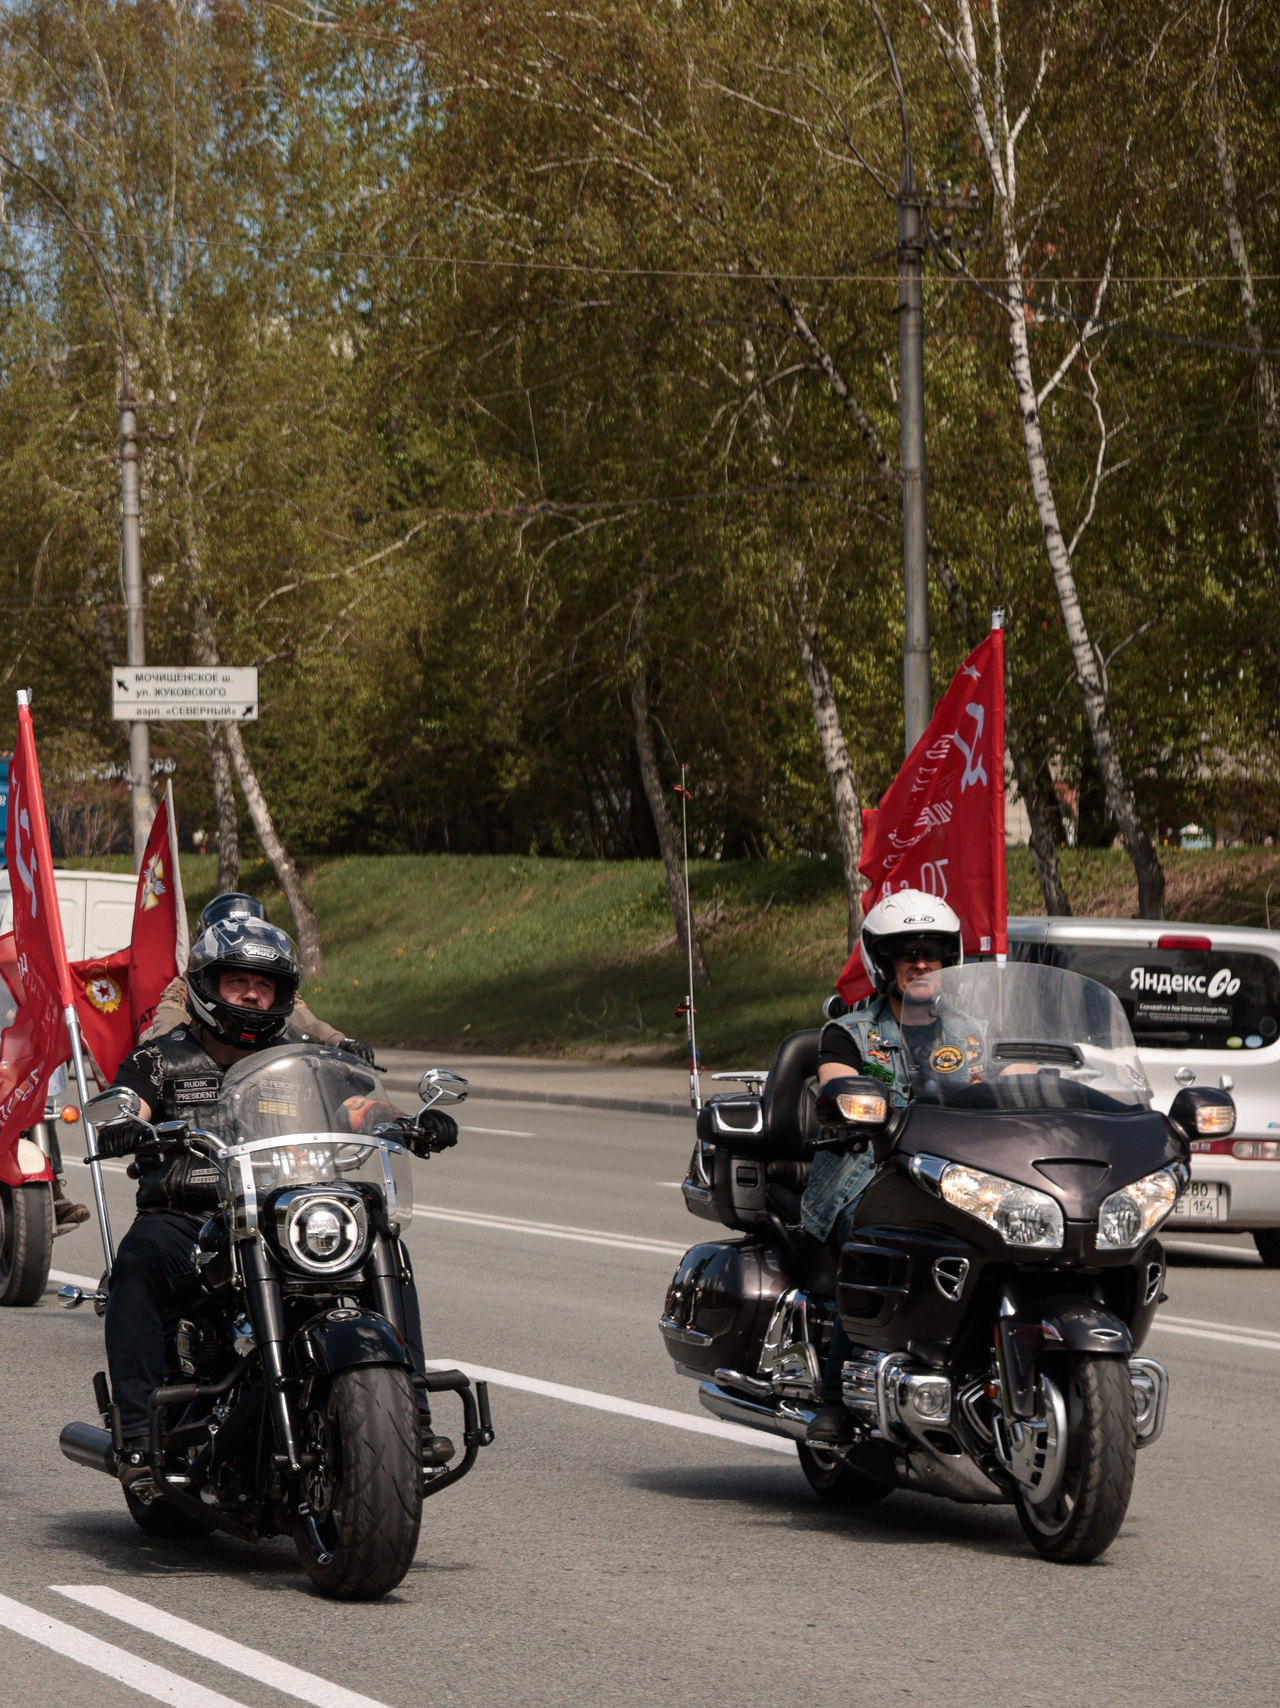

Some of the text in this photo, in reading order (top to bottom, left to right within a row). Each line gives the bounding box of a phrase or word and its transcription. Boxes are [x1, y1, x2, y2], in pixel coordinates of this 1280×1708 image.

[135, 673, 233, 683] МОЧИЩЕНСКОЕ ш.
[136, 687, 227, 699] ул. ЖУКОВСКОГО
[166, 704, 237, 716] «СЕВЕРНЫЙ»
[1130, 967, 1241, 998] Яндекс Go
[183, 1079, 208, 1089] RUDIK
[177, 1090, 217, 1101] PRESIDENT
[1193, 1200, 1213, 1212] 154
